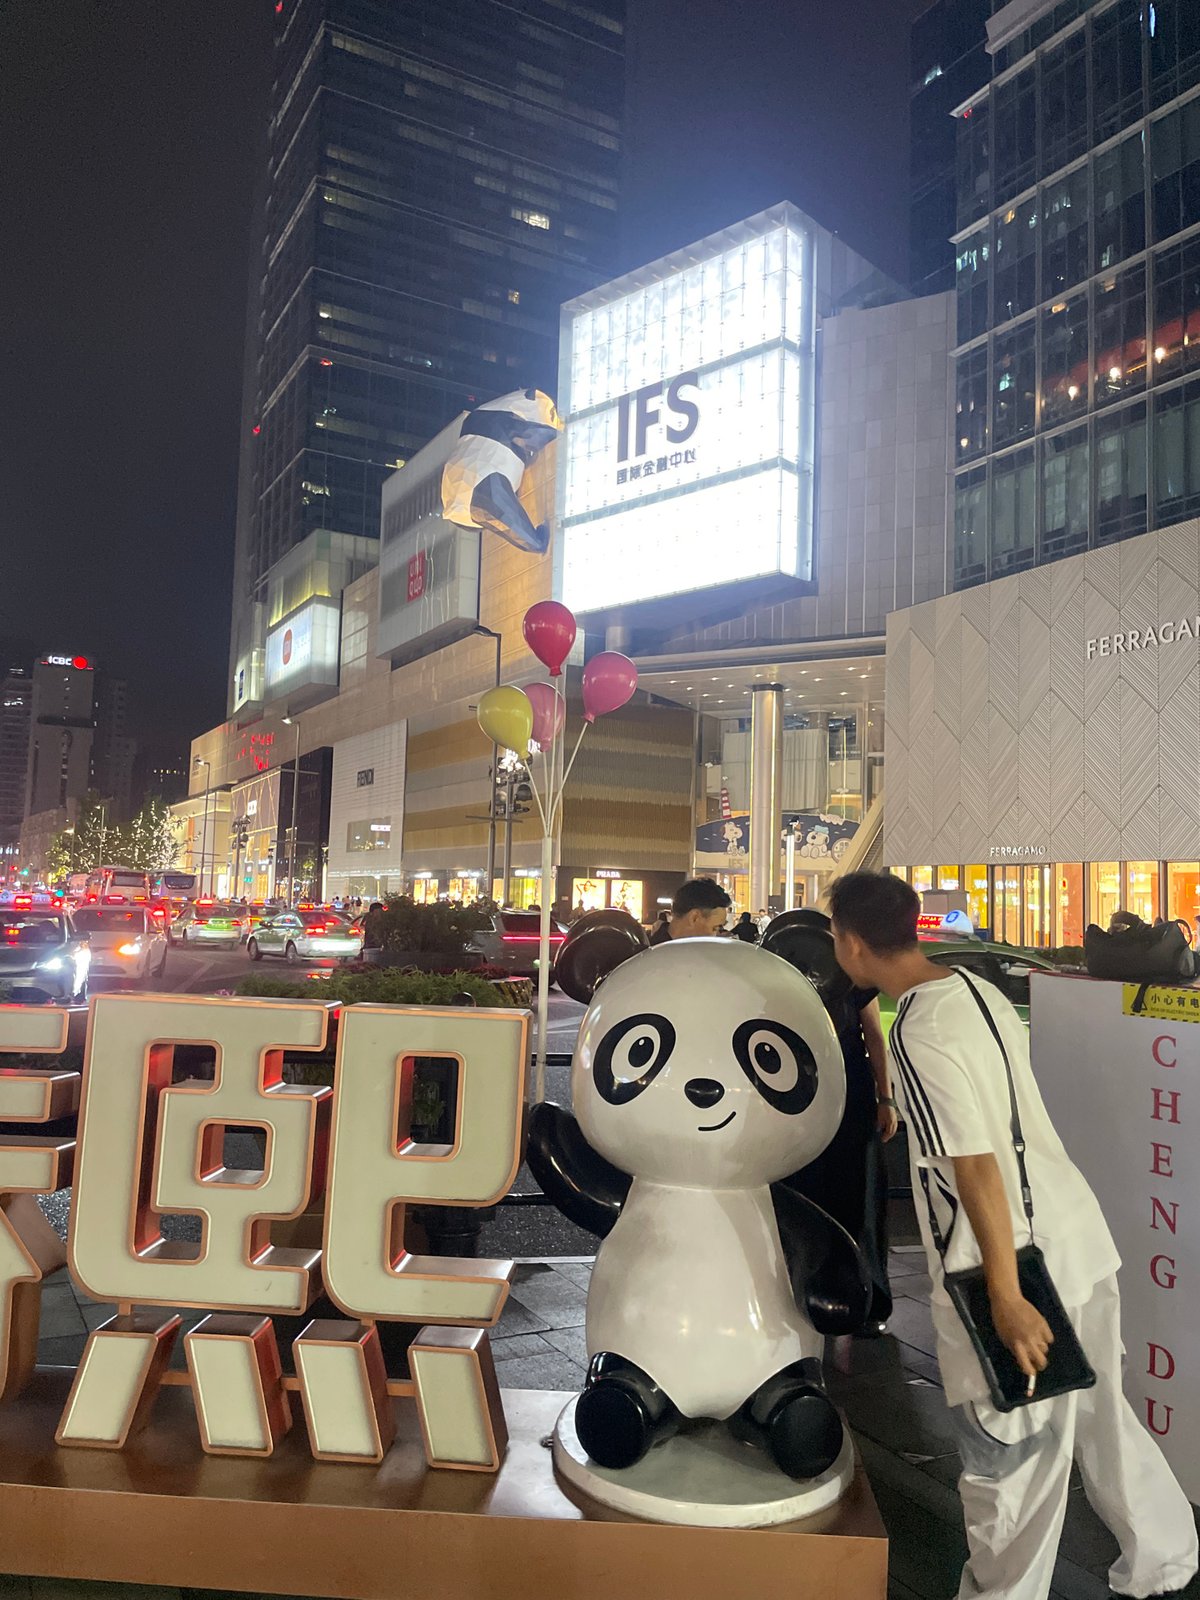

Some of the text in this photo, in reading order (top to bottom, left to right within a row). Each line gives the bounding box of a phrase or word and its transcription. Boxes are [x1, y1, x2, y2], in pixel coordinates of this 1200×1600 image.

[617, 371, 699, 463] IFS
[616, 448, 697, 484] 国际金融中心
[48, 656, 72, 666] ICBC
[990, 846, 1047, 857] FERRAGAMO
[596, 870, 621, 878] PRADA
[1151, 993, 1200, 1009] 小心有电
[1149, 1035, 1181, 1289] CHENG
[1146, 1342, 1175, 1436] DU
